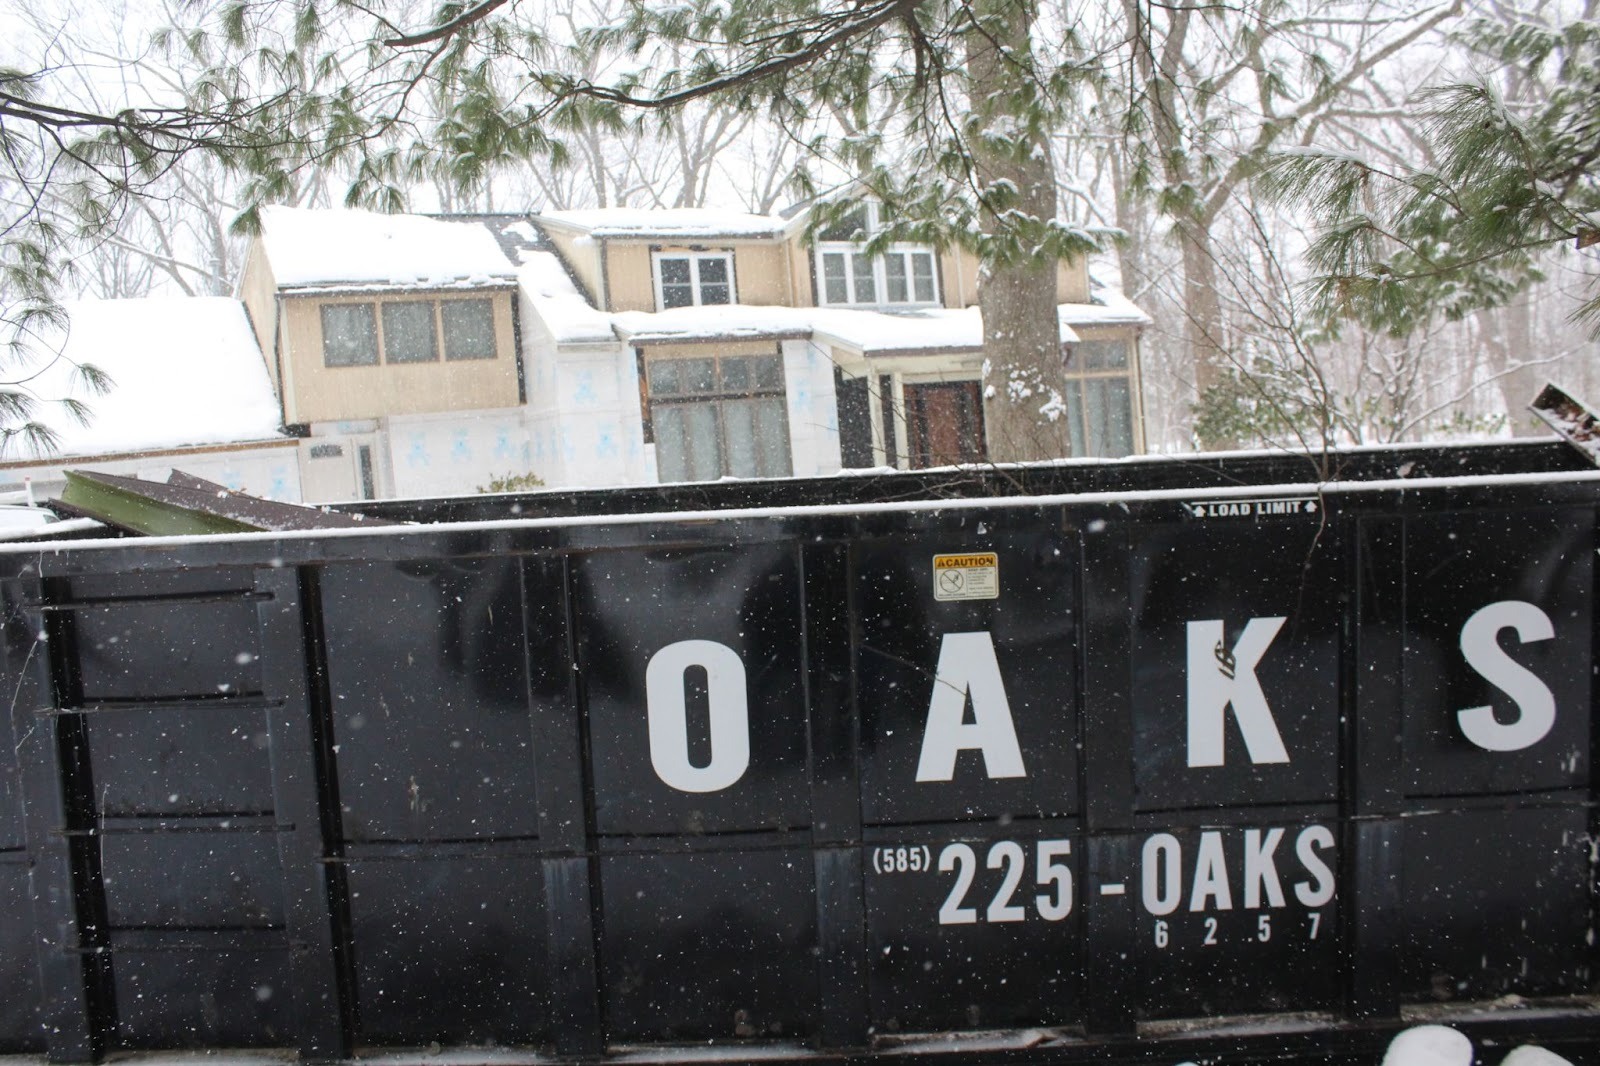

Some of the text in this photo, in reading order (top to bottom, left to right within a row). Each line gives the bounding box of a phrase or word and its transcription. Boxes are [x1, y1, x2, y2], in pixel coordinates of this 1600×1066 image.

[1209, 501, 1301, 517] LOAD LIMIT
[946, 557, 993, 568] CAUTION
[872, 847, 931, 875] (585)
